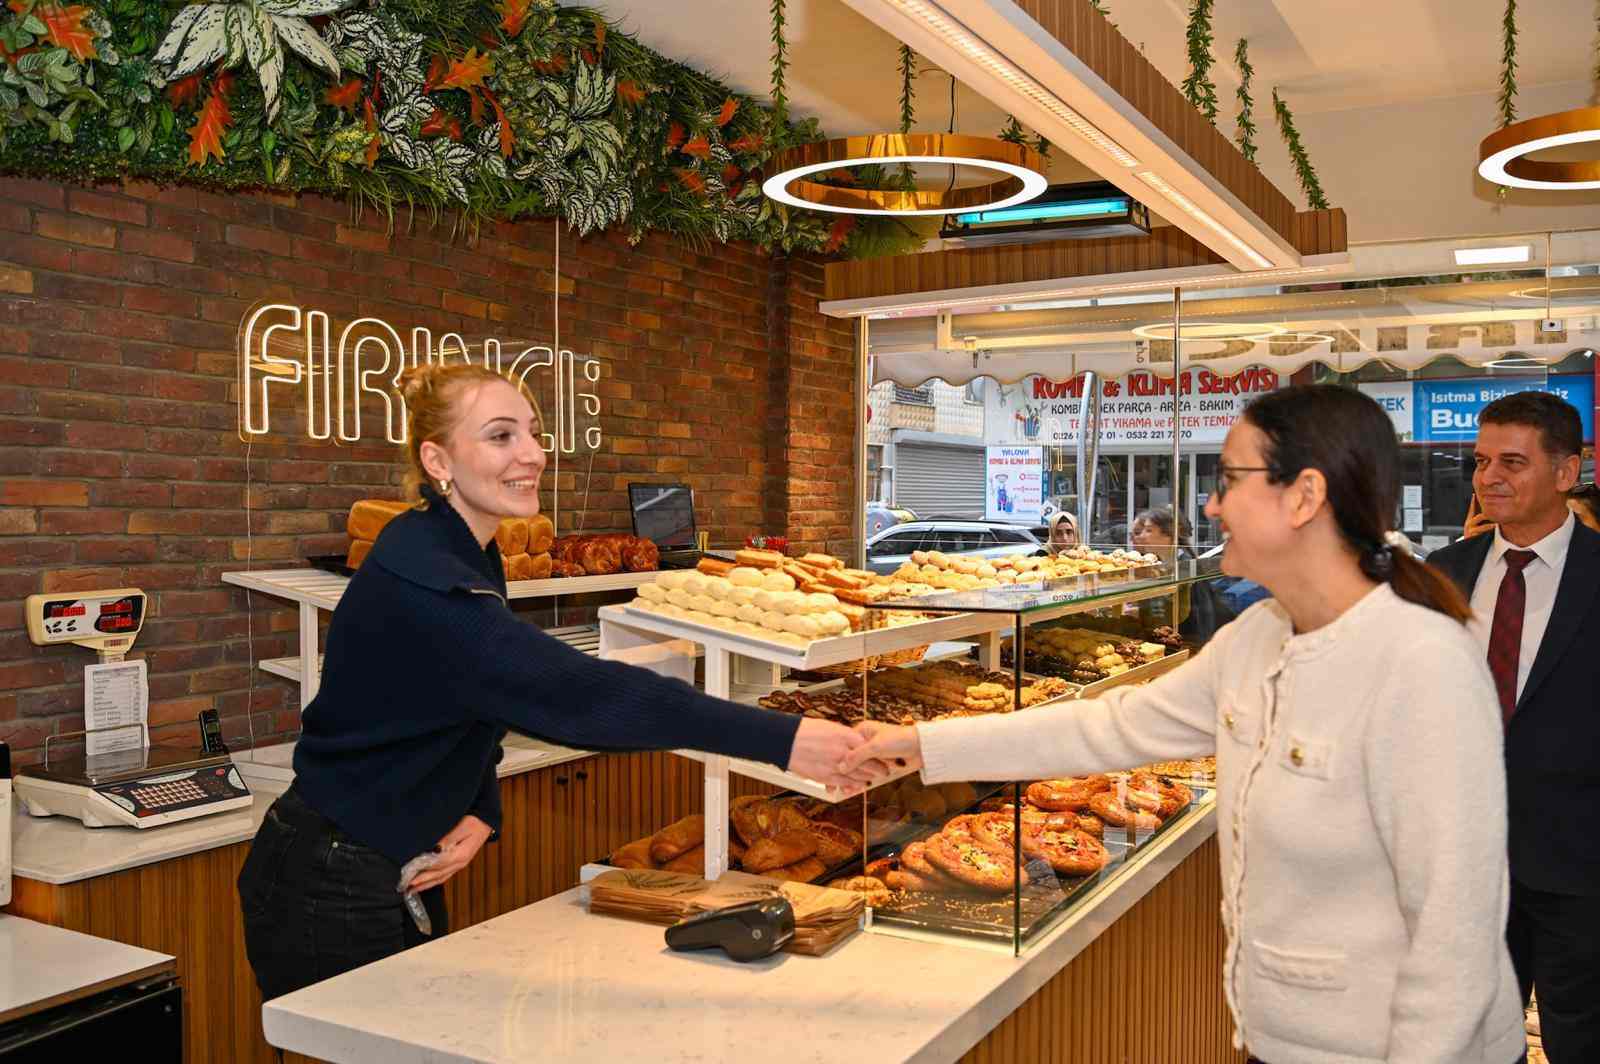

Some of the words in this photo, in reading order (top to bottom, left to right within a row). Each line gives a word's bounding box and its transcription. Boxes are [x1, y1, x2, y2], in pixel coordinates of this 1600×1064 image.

[239, 302, 577, 455] FIRCI
[1051, 404, 1081, 415] KOMB
[1118, 401, 1152, 415] PARÇA
[1160, 400, 1191, 413] ARZA
[1199, 399, 1234, 412] BAKIM
[1112, 416, 1152, 429] YIKAMA
[1154, 419, 1166, 428] ve
[1168, 415, 1200, 427] PTEK
[1203, 412, 1241, 427] TEMİZ
[1126, 430, 1148, 439] 0532
[1150, 430, 1164, 439] 221
[1181, 430, 1192, 439] 70
